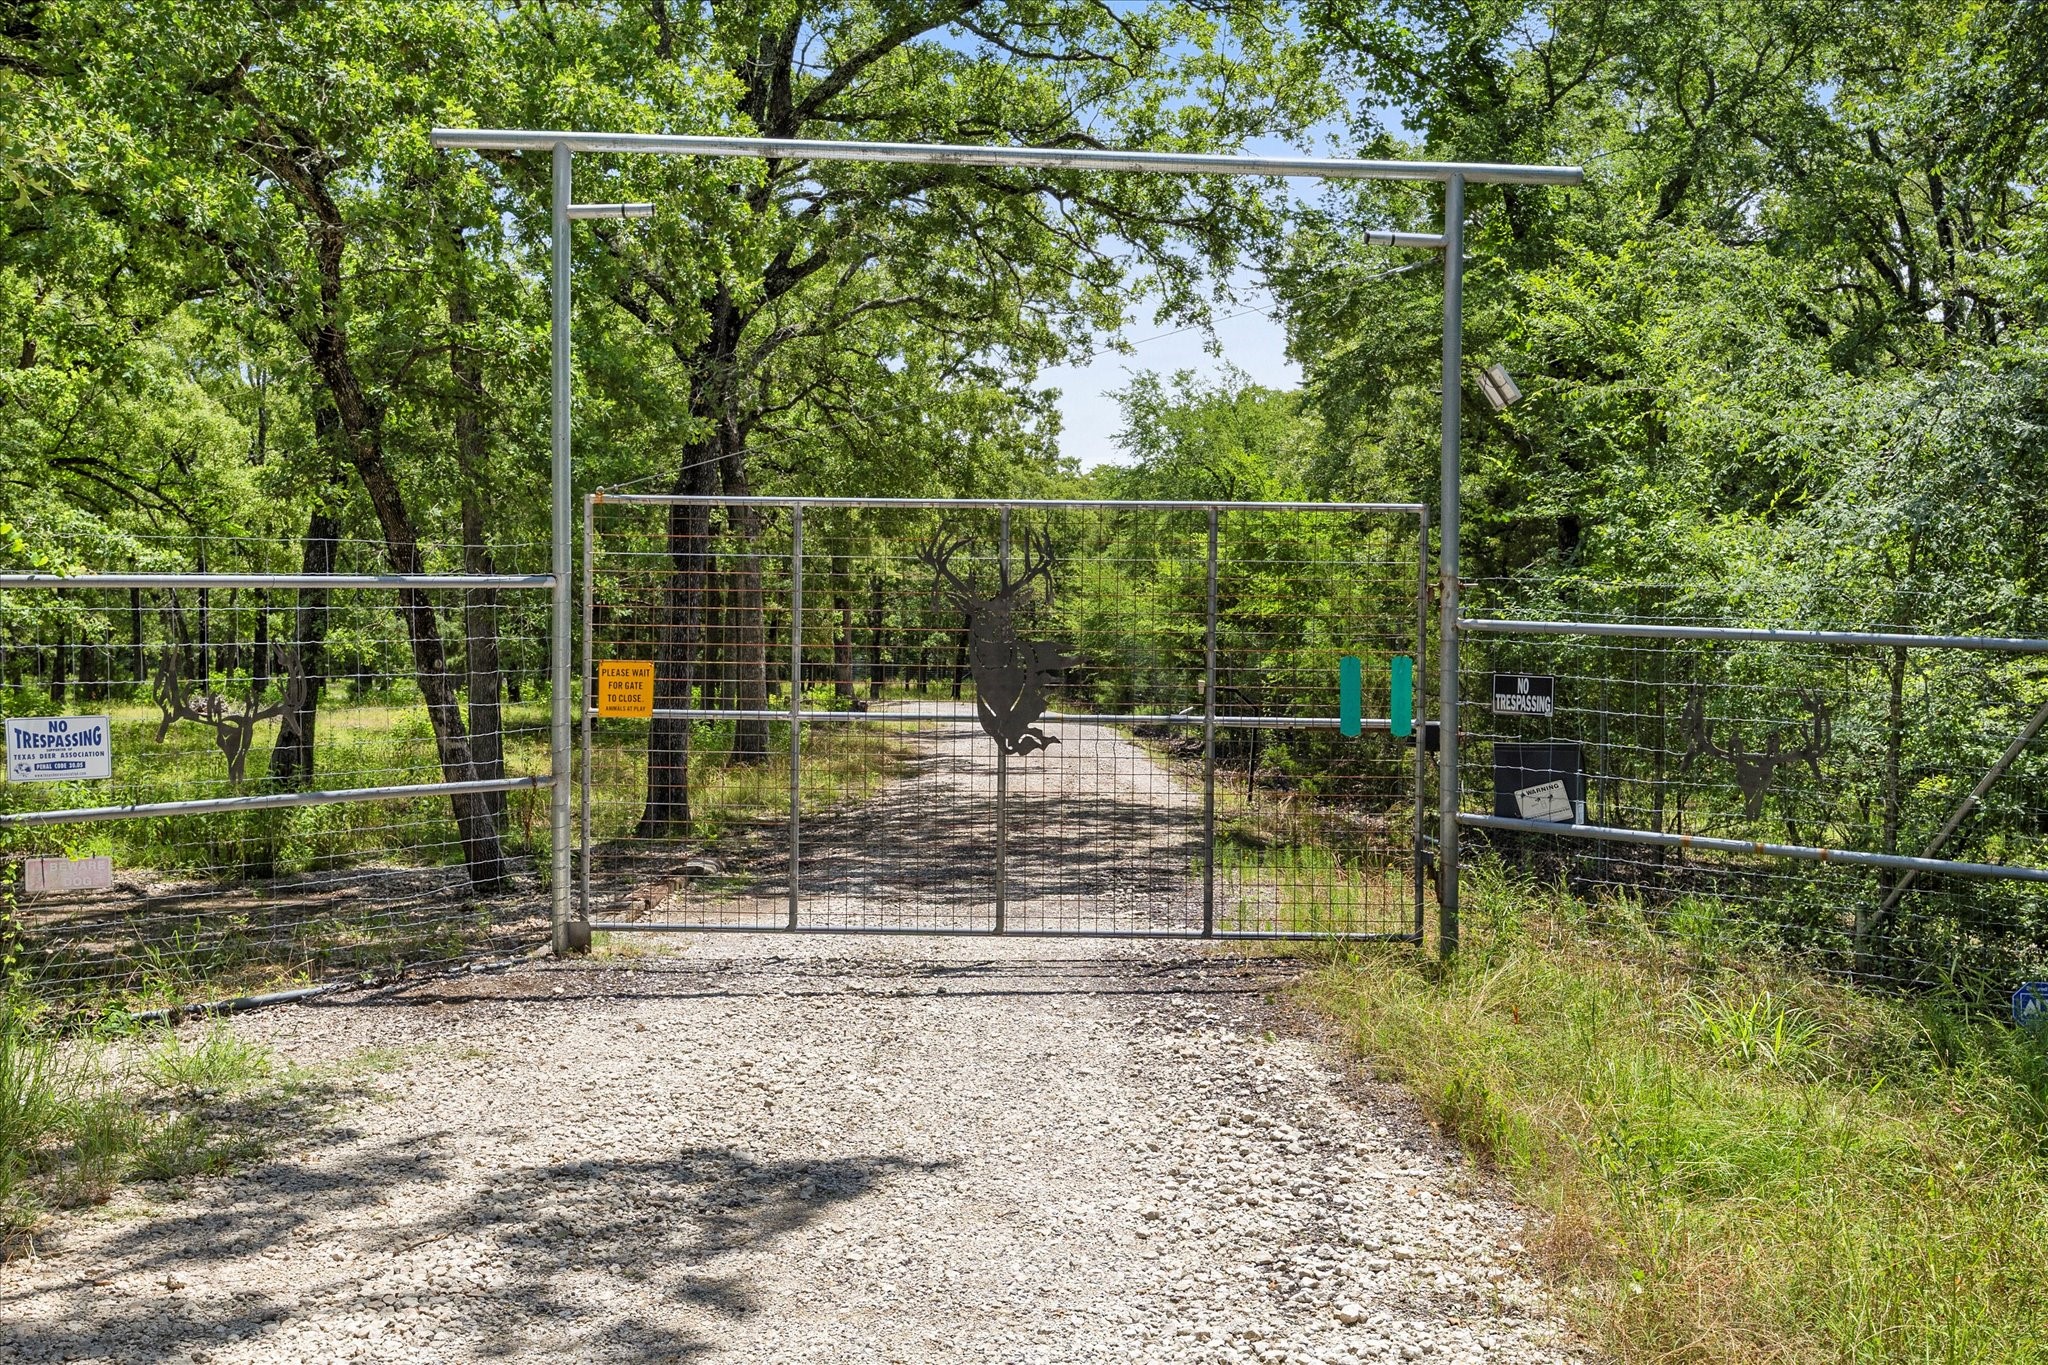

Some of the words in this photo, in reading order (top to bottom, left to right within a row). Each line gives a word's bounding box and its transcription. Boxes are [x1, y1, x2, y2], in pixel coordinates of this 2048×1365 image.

[602, 669, 630, 677] PLEASE
[632, 669, 650, 677] WAIT
[608, 682, 623, 690] FOR
[625, 682, 643, 690] GATE
[1517, 677, 1529, 694] NO
[608, 694, 617, 702] TO
[1495, 694, 1551, 712] TRESPASSING
[49, 720, 67, 733] NO
[14, 726, 102, 749] TRESPASSING
[1525, 783, 1560, 796] WARNING
[50, 860, 106, 872] BEWARE
[64, 877, 92, 887] DOG
